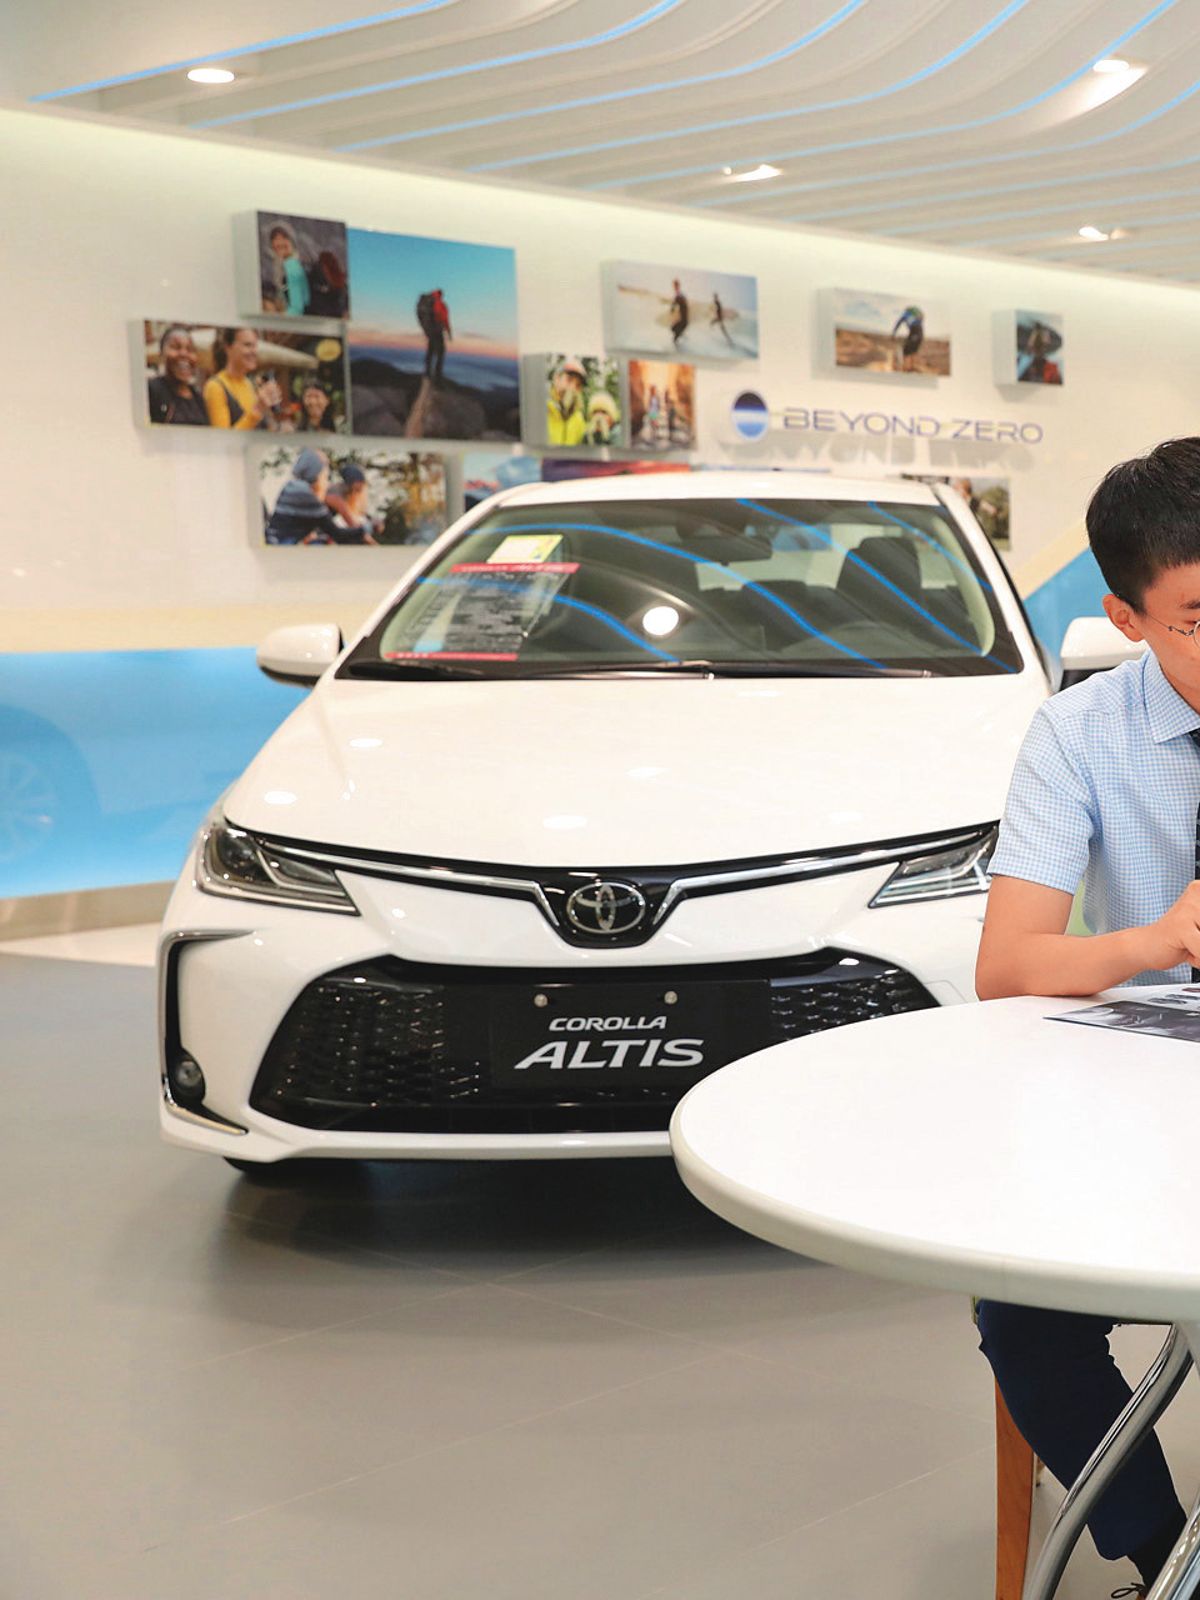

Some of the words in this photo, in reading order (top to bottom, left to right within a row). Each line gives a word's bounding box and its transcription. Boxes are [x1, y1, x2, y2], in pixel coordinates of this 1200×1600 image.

[783, 407, 941, 437] BEYOND
[951, 418, 1044, 444] ZERO
[549, 1015, 667, 1032] COROLLA
[514, 1038, 704, 1069] ALTIS
